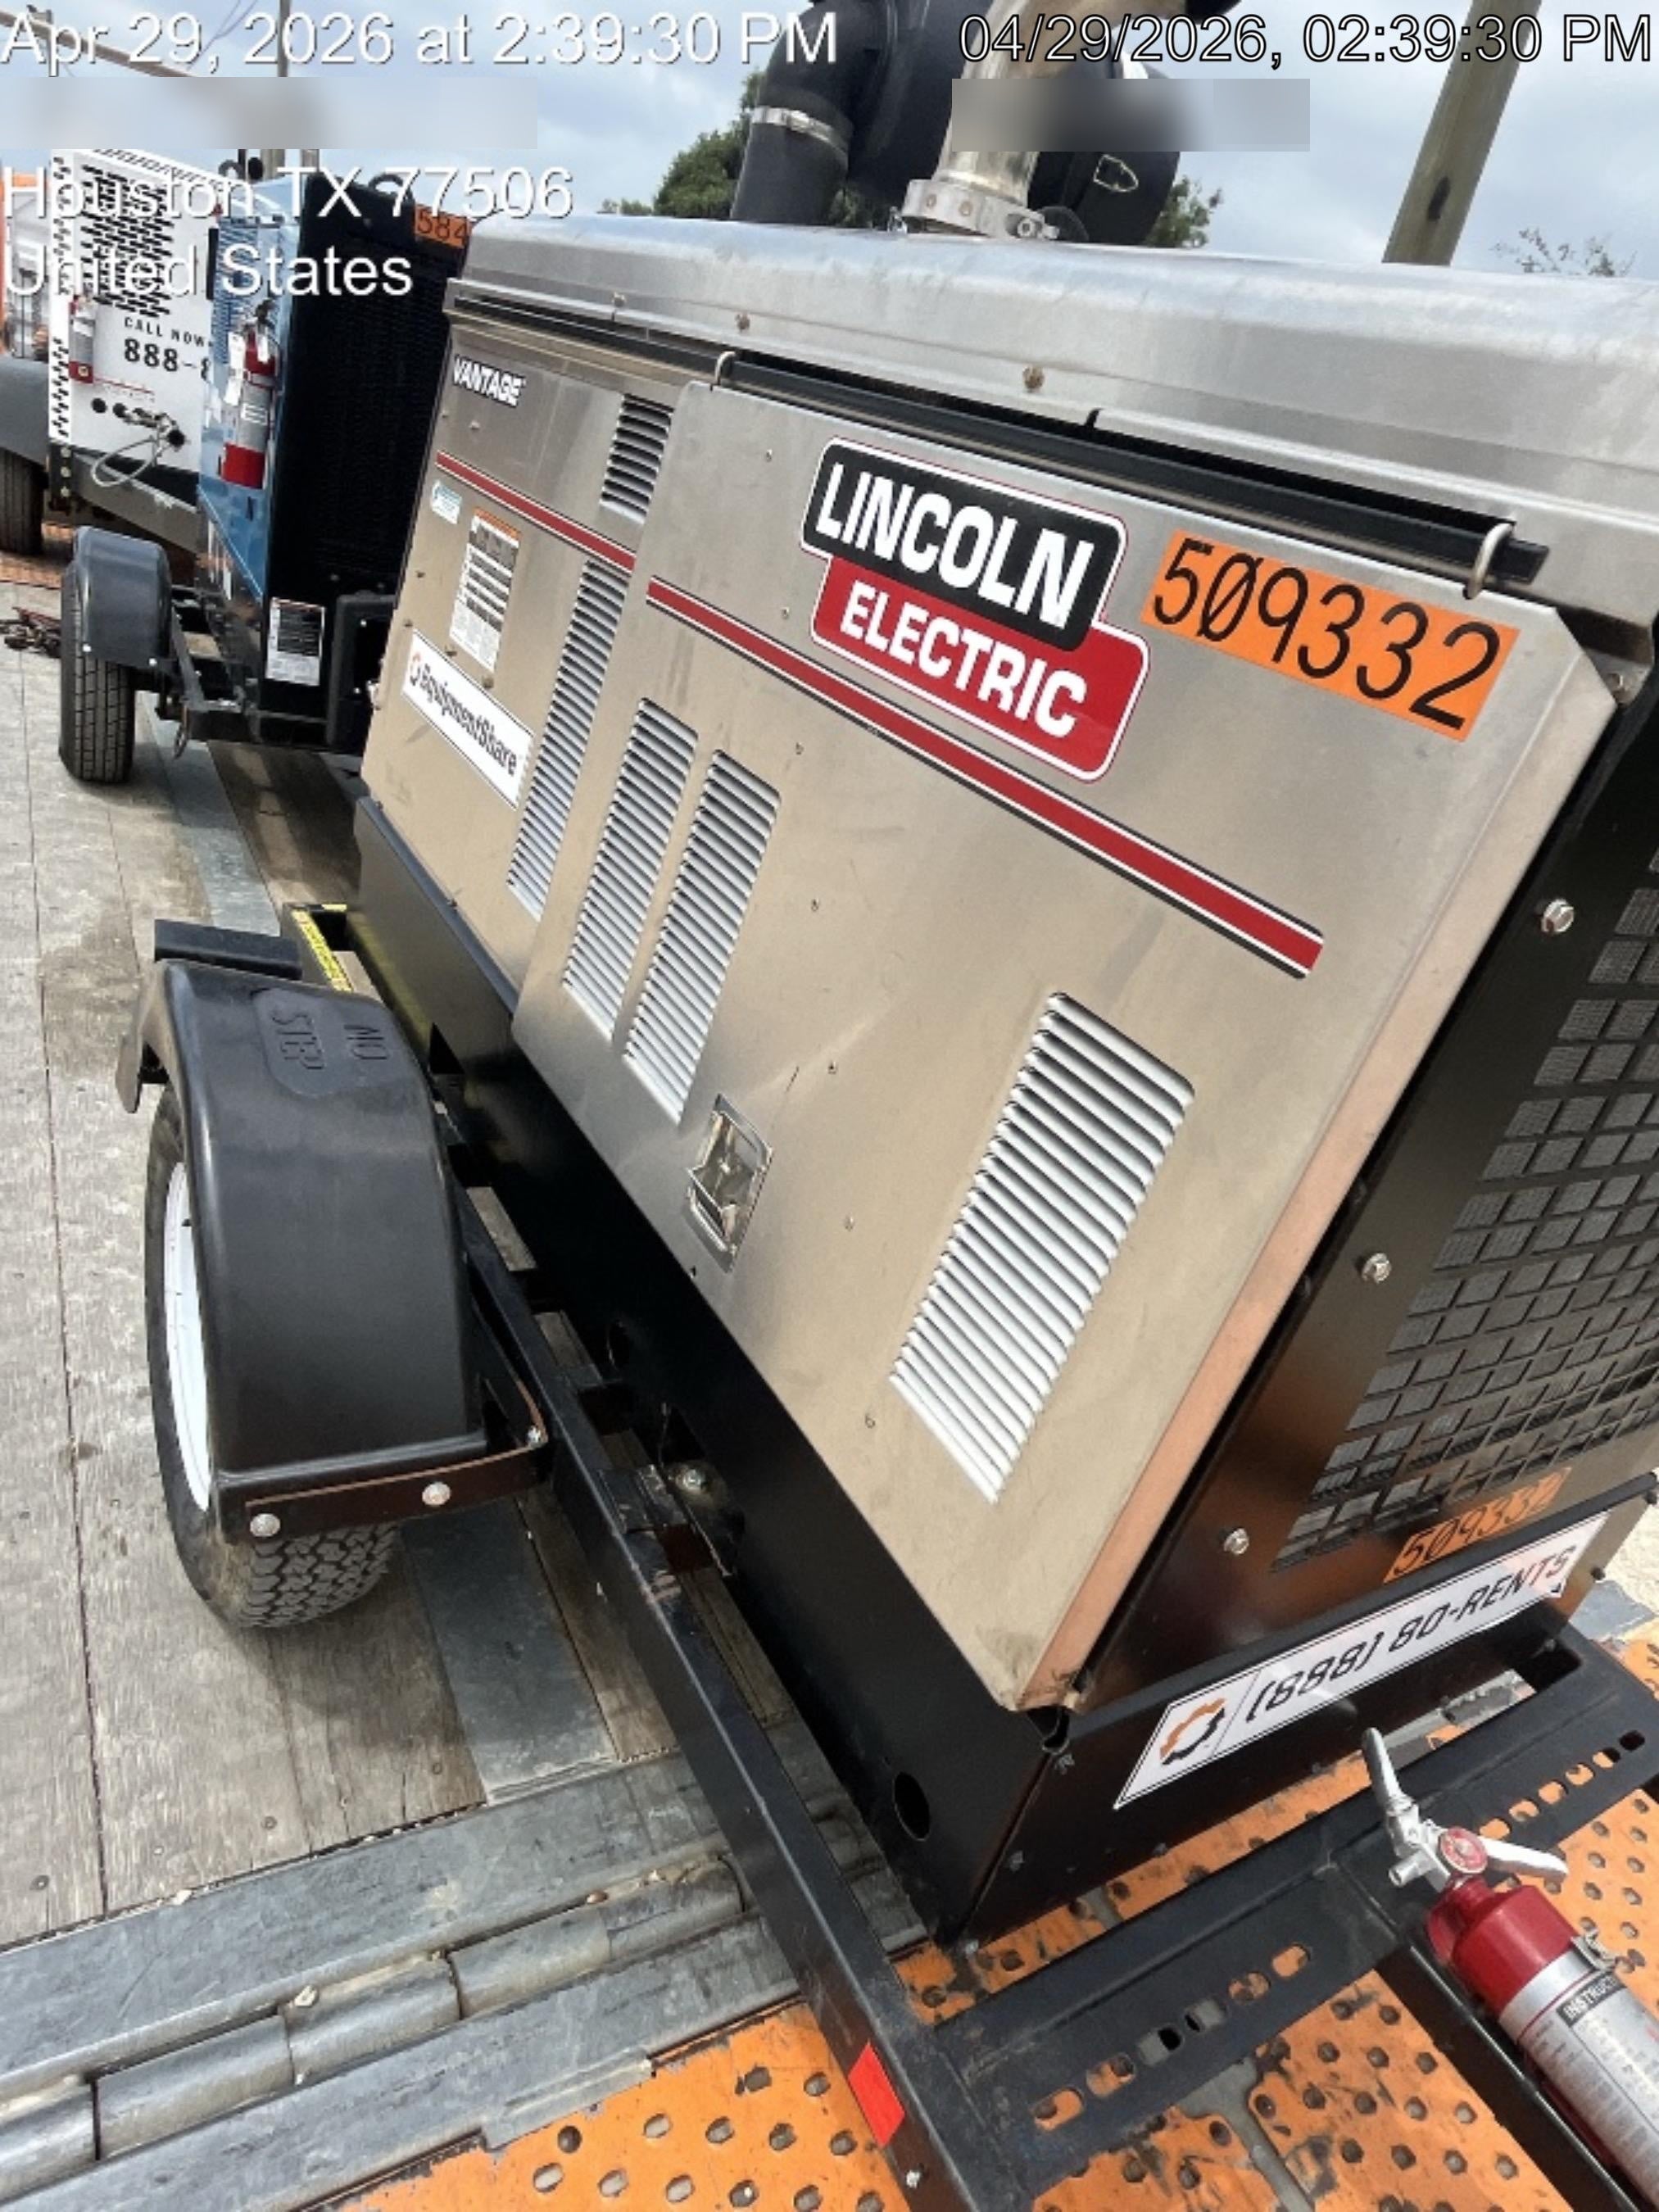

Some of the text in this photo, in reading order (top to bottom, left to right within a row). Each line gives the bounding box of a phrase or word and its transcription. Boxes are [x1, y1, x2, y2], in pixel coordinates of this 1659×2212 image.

[816, 463, 1095, 630] LINCOLN
[840, 579, 1087, 737] ELECTRIC
[1154, 537, 1499, 731] 509332
[1389, 1545, 1577, 1653] 80-RENTS
